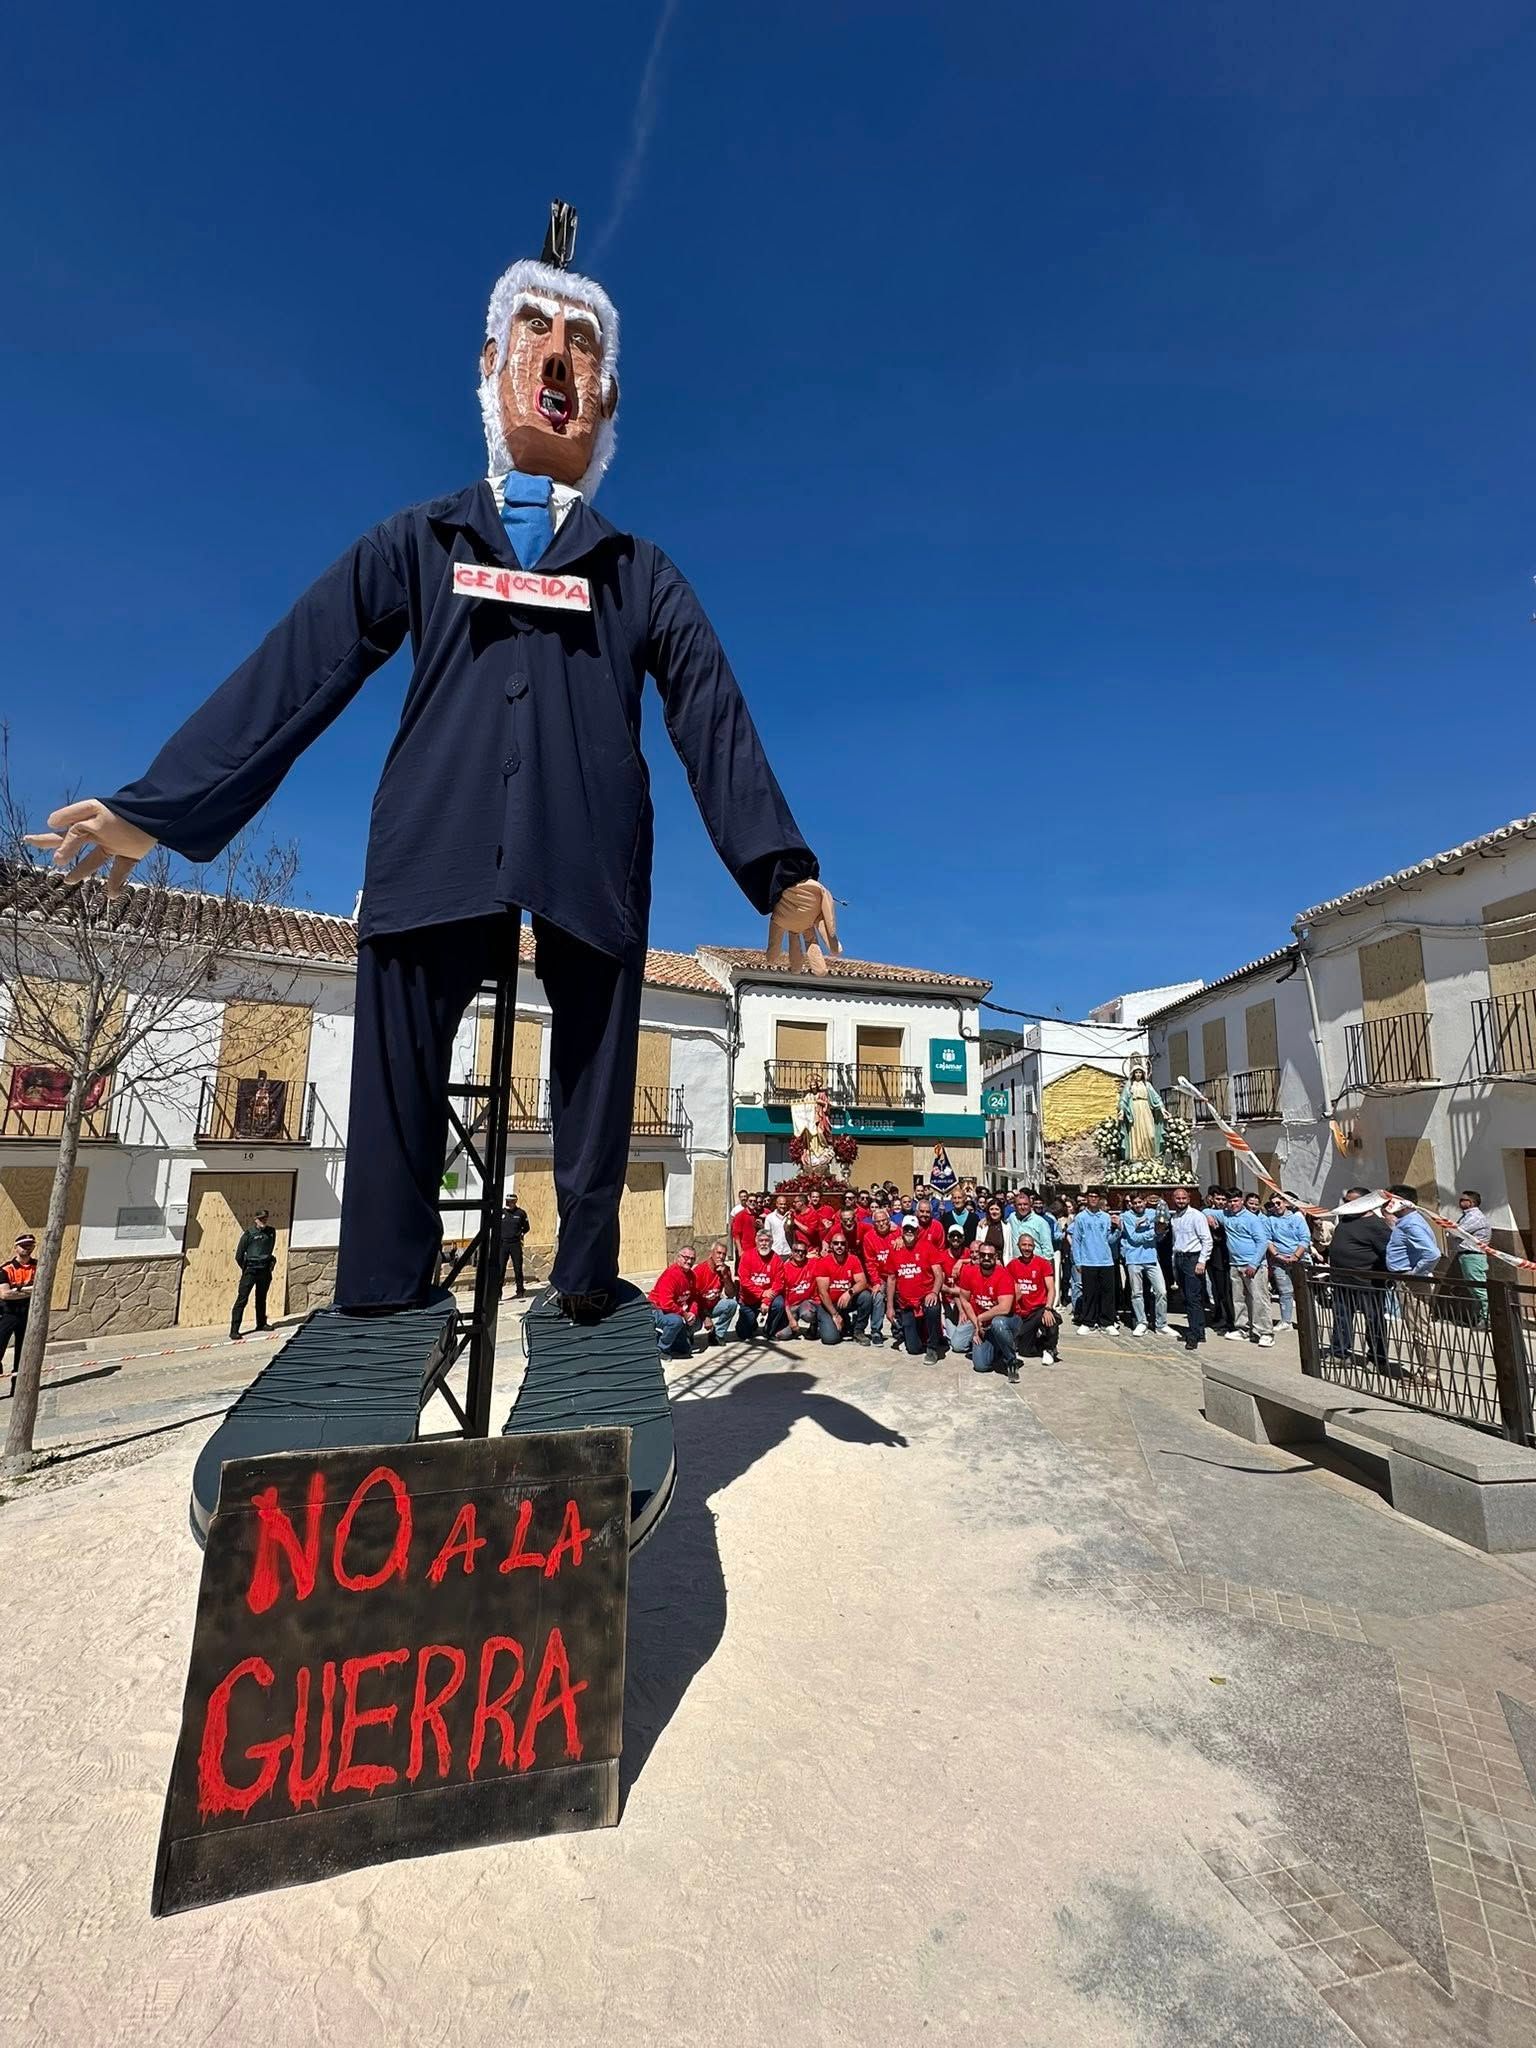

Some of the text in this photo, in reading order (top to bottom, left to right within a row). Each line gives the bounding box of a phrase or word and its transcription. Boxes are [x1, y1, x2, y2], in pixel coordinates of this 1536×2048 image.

[456, 569, 589, 604] GENOCIDA
[935, 1062, 963, 1070] cajamar
[247, 1467, 590, 1614] NO A LA
[198, 1628, 587, 1814] GUERRA
